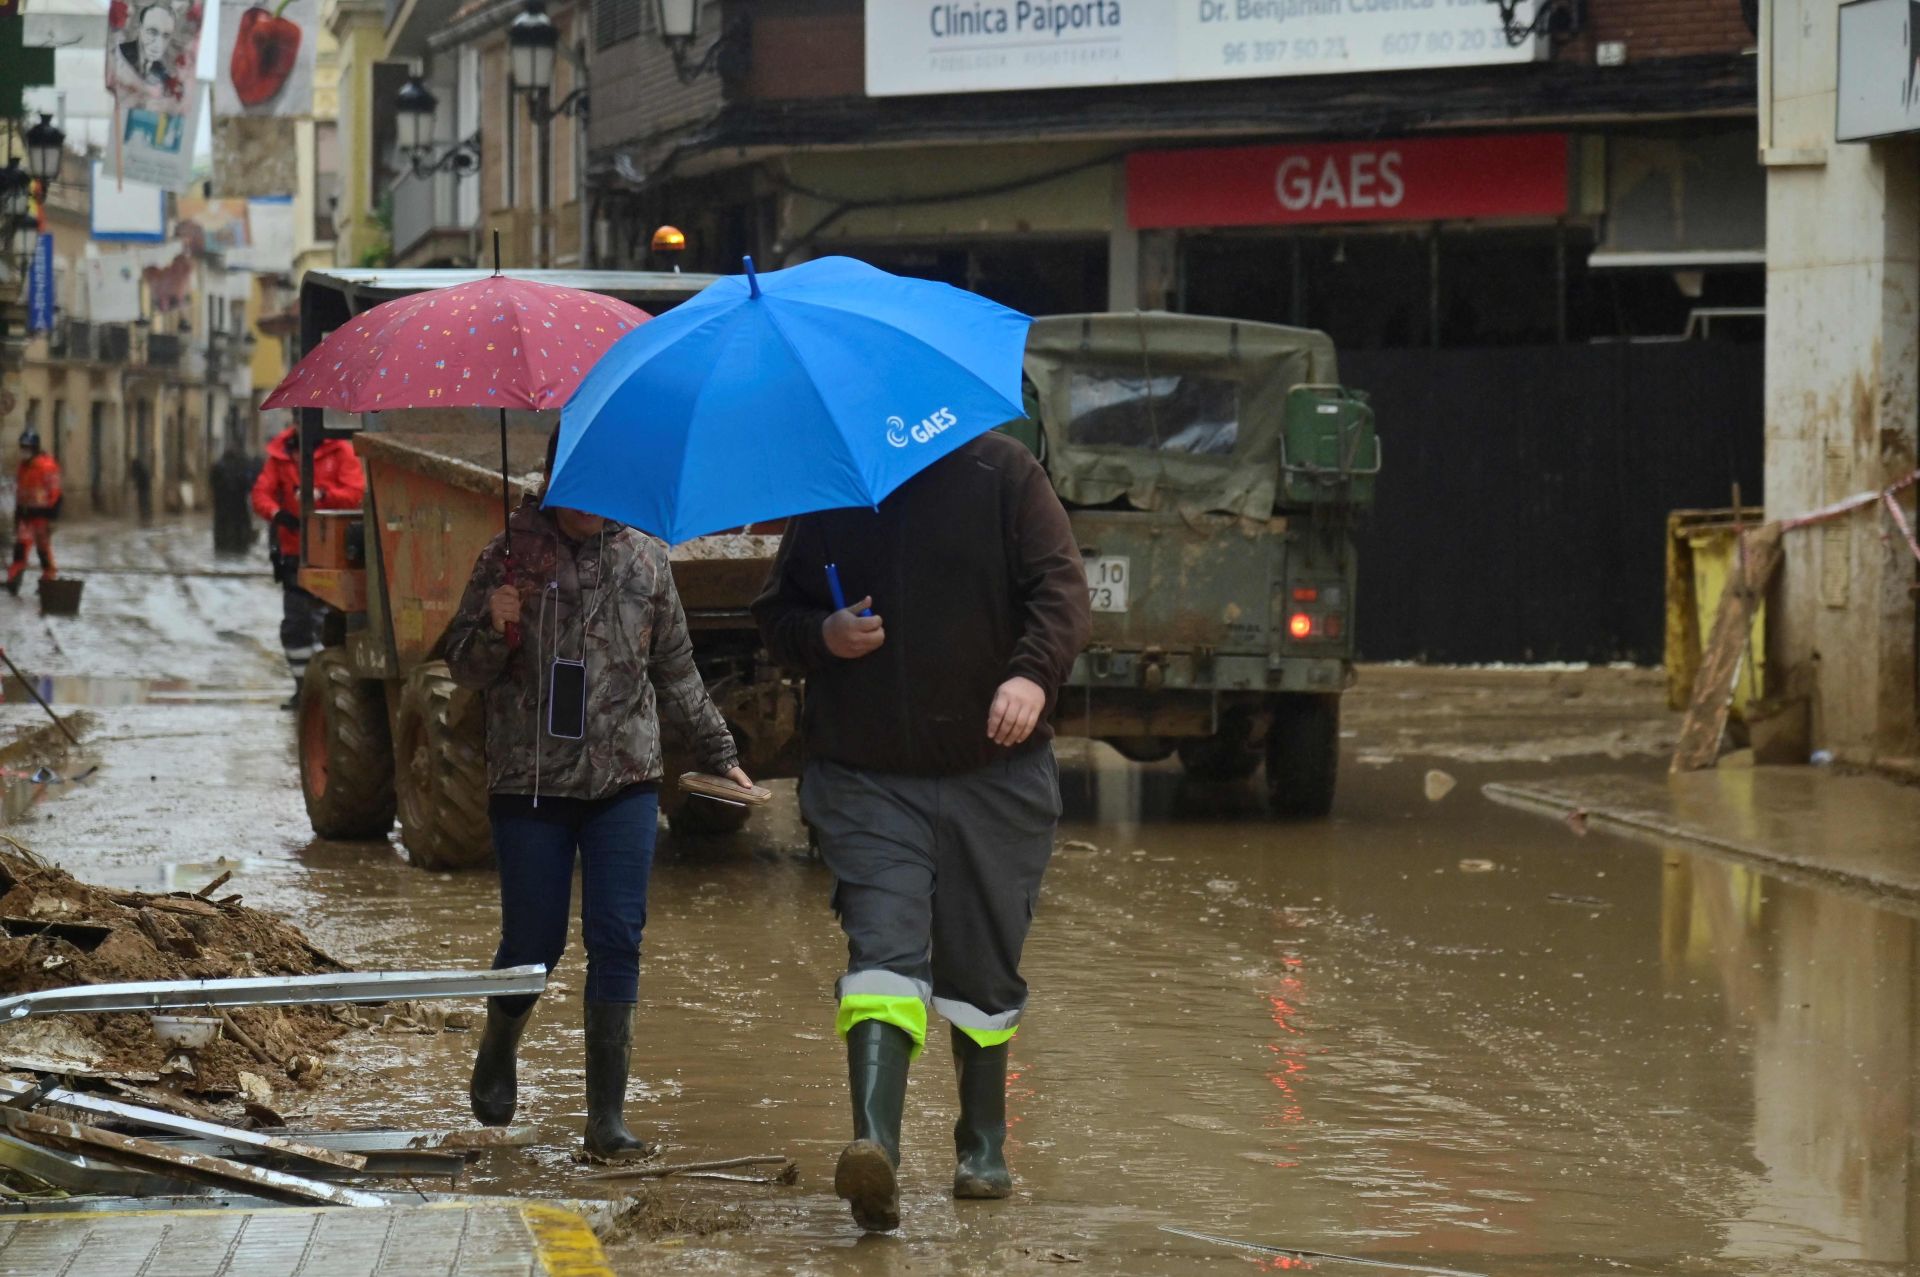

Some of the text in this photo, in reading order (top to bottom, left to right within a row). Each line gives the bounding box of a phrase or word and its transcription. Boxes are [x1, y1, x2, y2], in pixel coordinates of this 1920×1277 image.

[930, 0, 1121, 37] Clínica Paiporta
[1199, 0, 1229, 22] Dr.
[1275, 151, 1405, 211] GAES
[910, 407, 957, 443] GAES
[1100, 562, 1124, 584] 10
